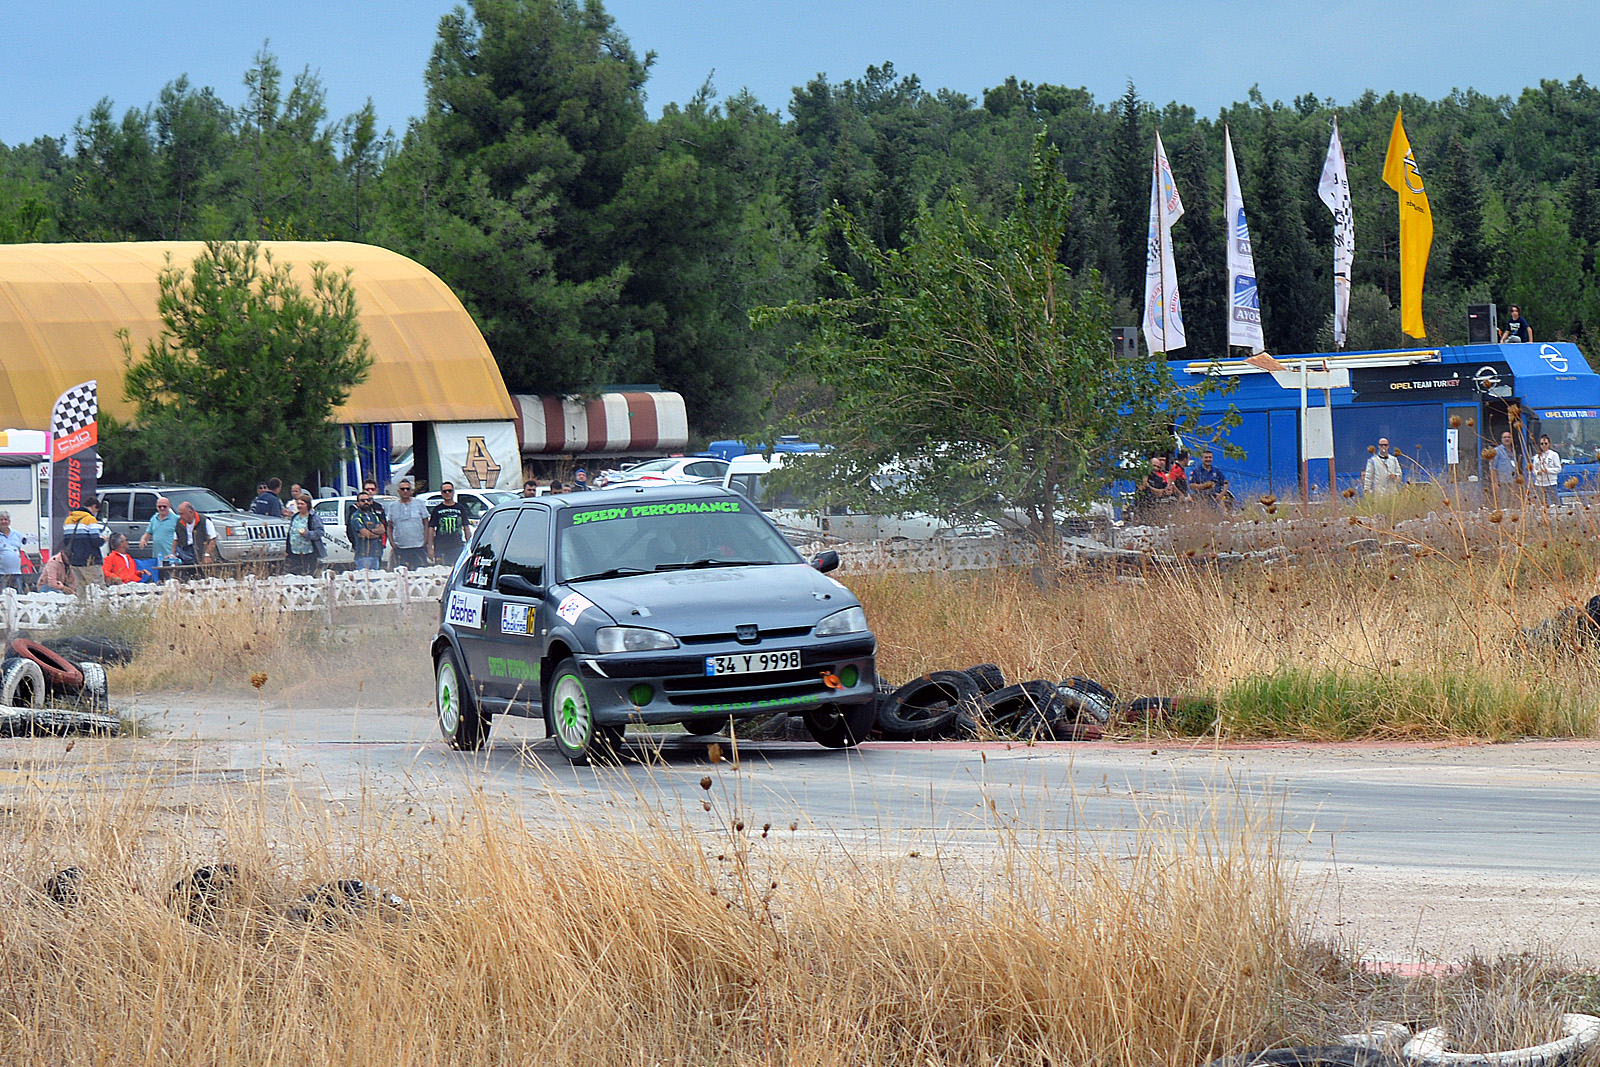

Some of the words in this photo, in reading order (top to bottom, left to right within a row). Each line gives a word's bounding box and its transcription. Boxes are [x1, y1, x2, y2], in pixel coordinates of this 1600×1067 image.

[1390, 382, 1413, 390] OPEL
[1413, 380, 1432, 389] TEAM
[1433, 379, 1460, 388] TURKEY
[1562, 410, 1577, 418] TEAM
[1577, 410, 1597, 418] TURKEY
[57, 430, 90, 452] CMD
[68, 457, 82, 509] SERVIS
[572, 507, 629, 525] SPEEDY
[631, 501, 741, 518] PERFORMANCE
[450, 594, 477, 623] Becher
[715, 657, 736, 674] 34
[743, 655, 753, 672] Y
[760, 652, 799, 670] 9998
[691, 702, 752, 713] SPEEDY
[758, 695, 819, 708] GARAGE
